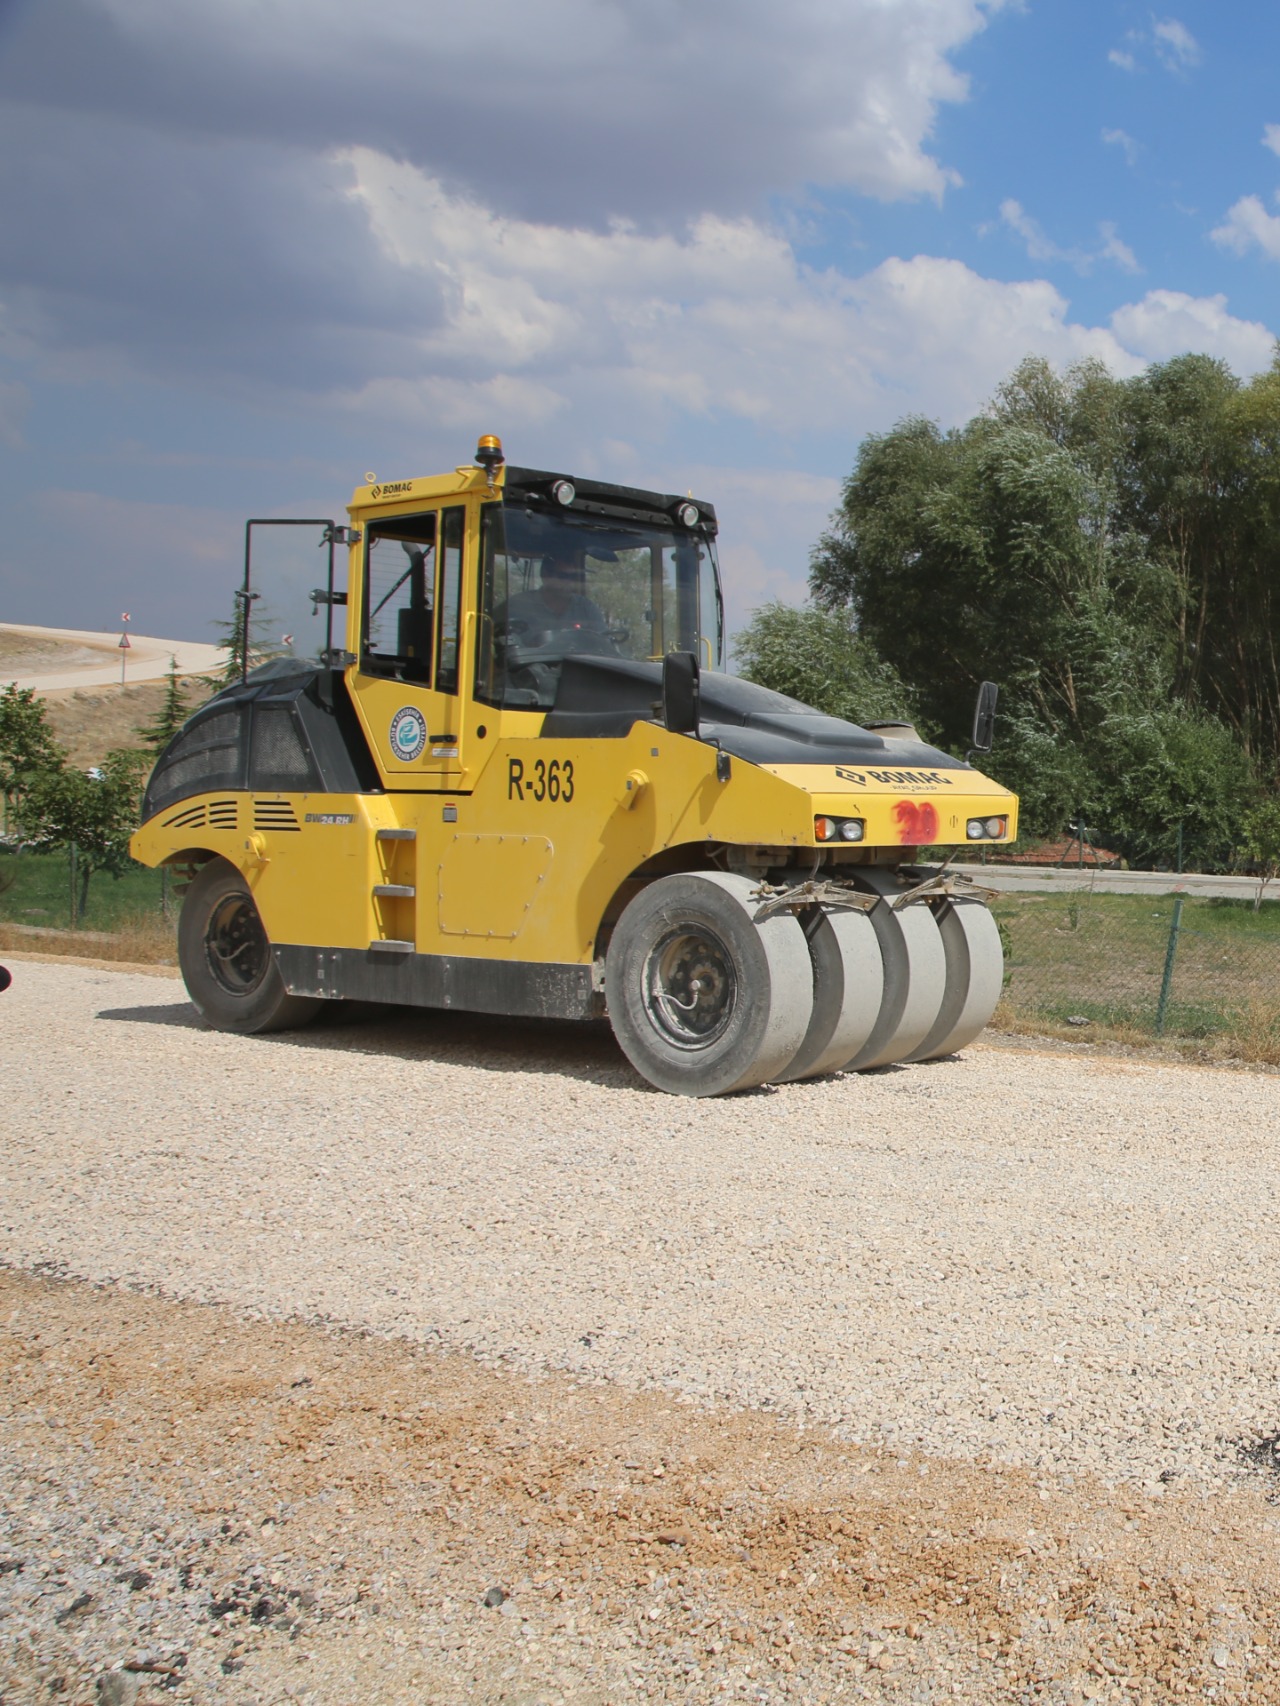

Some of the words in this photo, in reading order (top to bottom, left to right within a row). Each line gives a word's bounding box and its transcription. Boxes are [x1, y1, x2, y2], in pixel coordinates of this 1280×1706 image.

[383, 482, 412, 494] BOMAG
[508, 758, 575, 803] R-363
[866, 771, 953, 784] BOMAG
